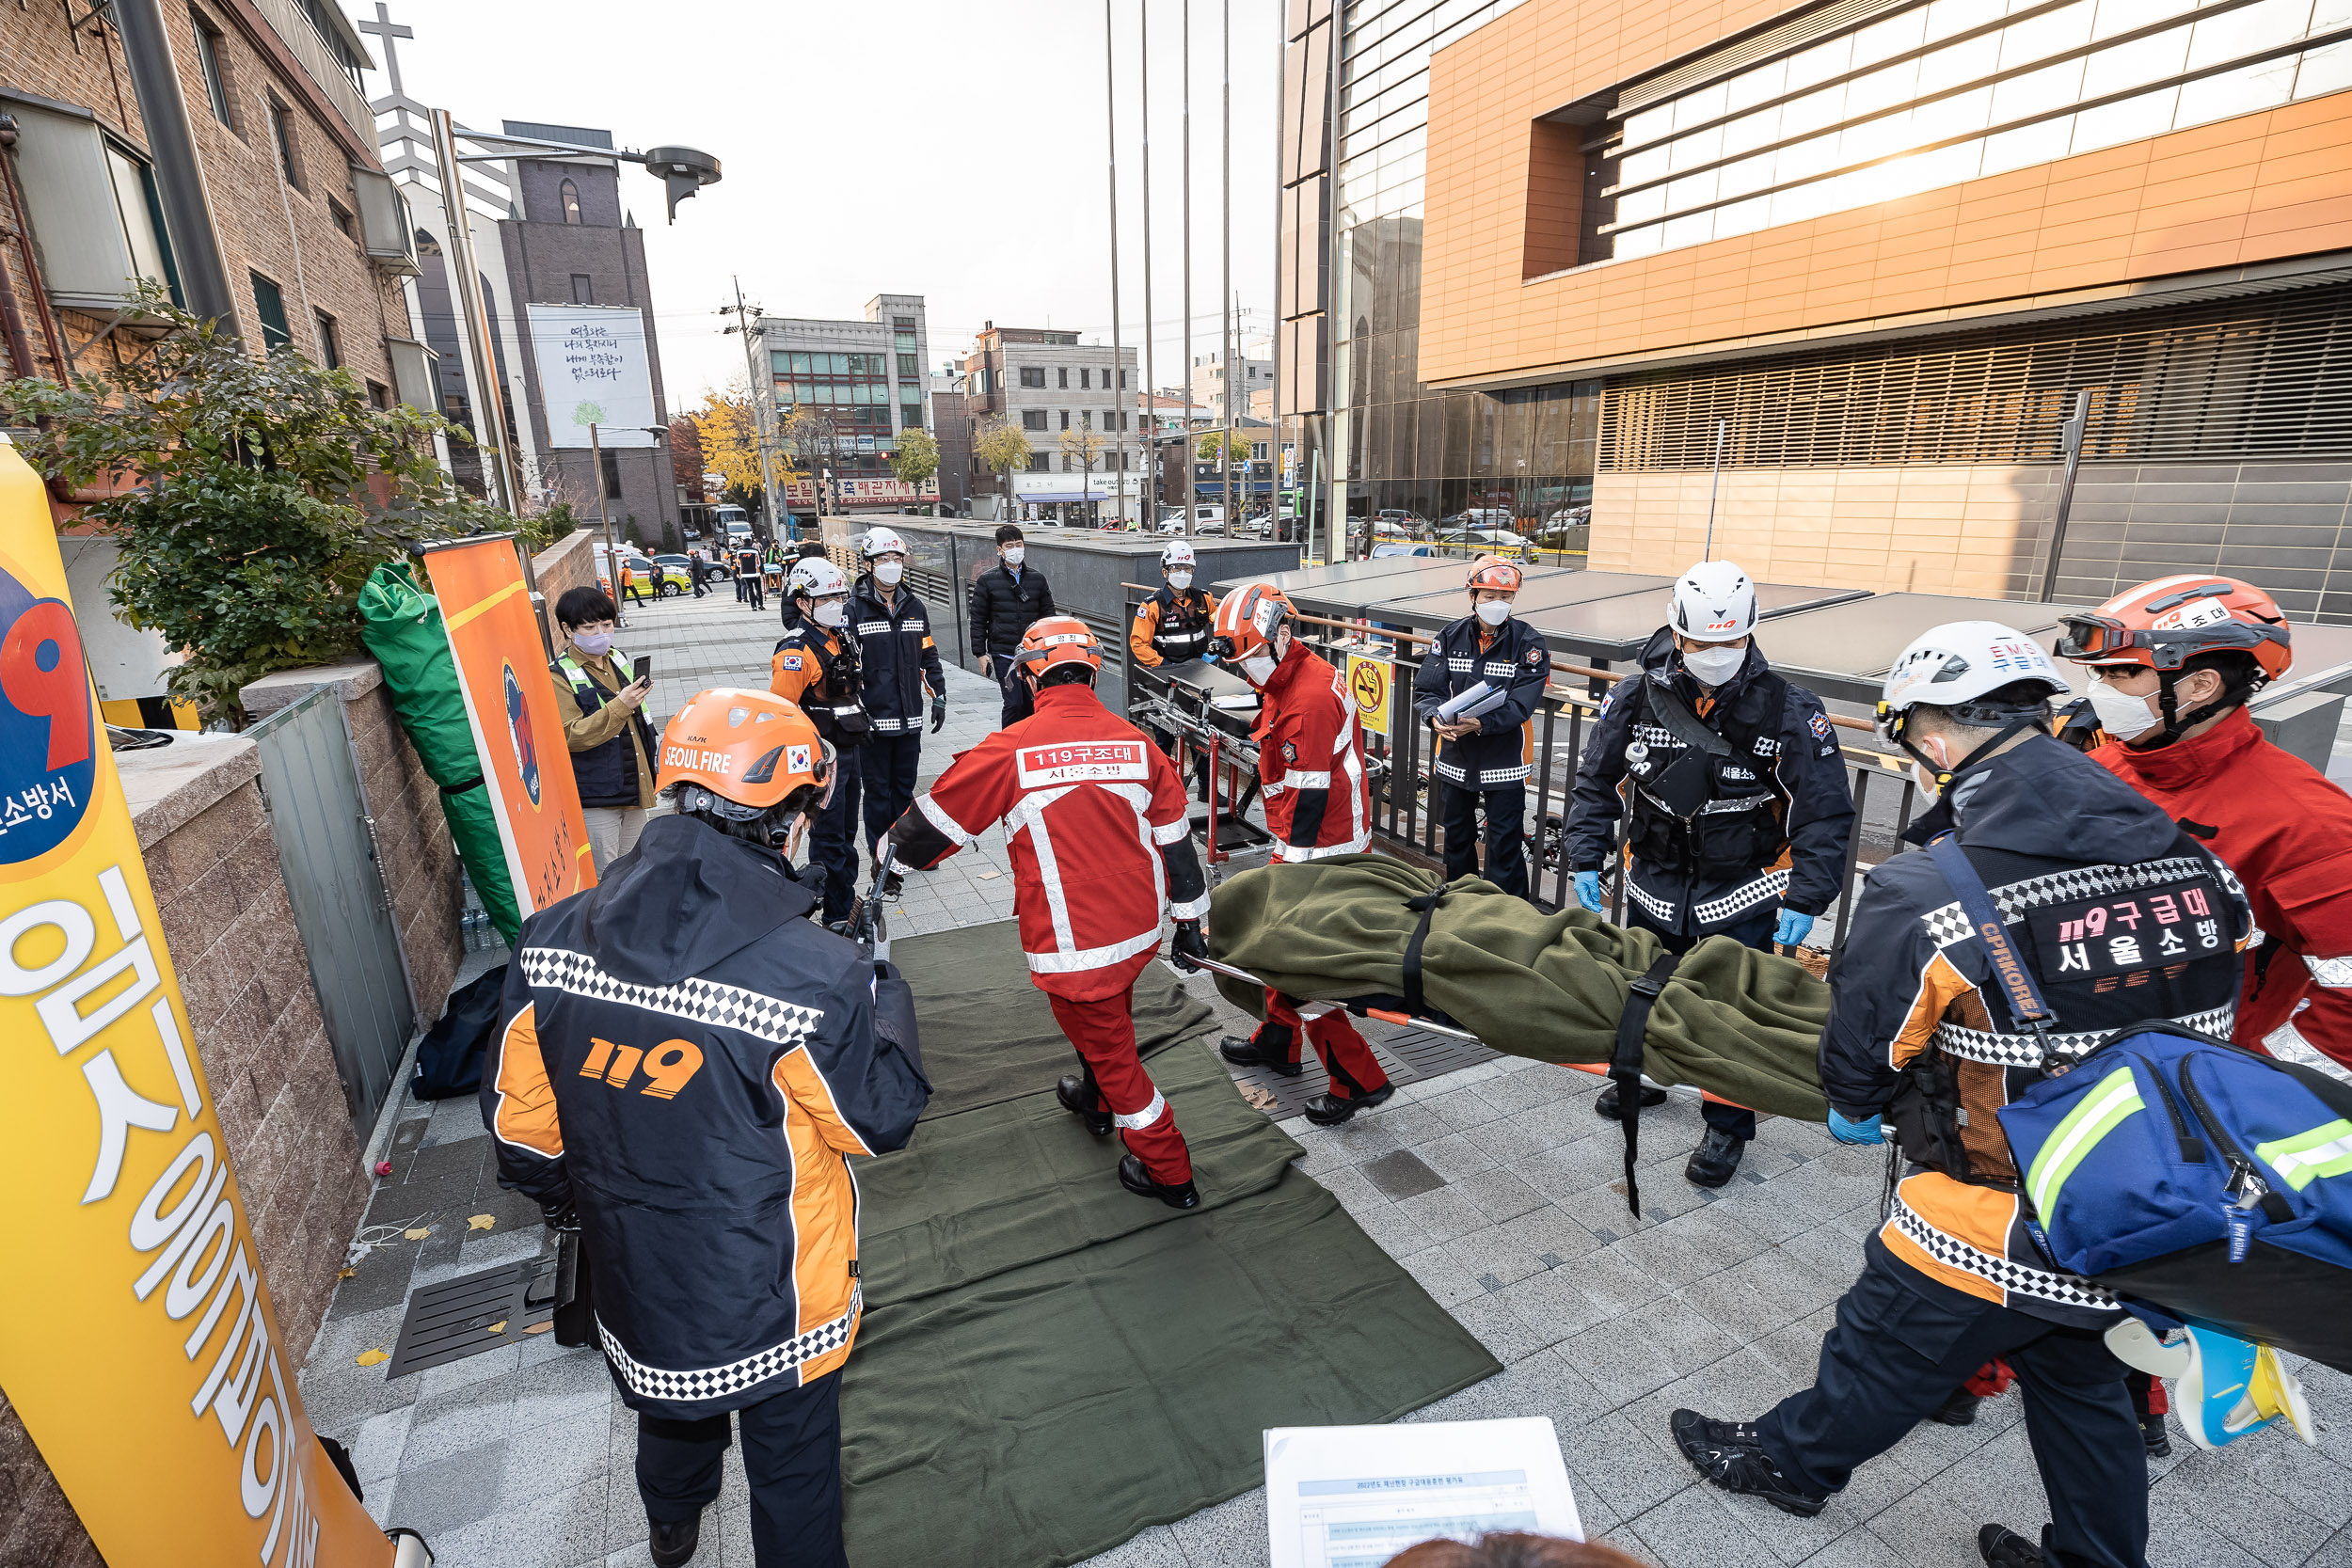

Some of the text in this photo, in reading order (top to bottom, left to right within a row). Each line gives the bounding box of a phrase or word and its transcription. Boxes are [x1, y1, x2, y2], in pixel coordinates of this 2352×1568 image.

[564, 339, 617, 352] 나의 목자시니
[566, 353, 623, 366] 내게 부족함이
[1989, 643, 2037, 658] EMS
[1992, 656, 2050, 673] 구급대
[664, 745, 733, 774] SEOUL FIRE
[1035, 747, 1133, 767] 119구조대
[0, 775, 76, 837] 소방서
[2058, 918, 2219, 973] 서울소방
[579, 1037, 705, 1101] 119
